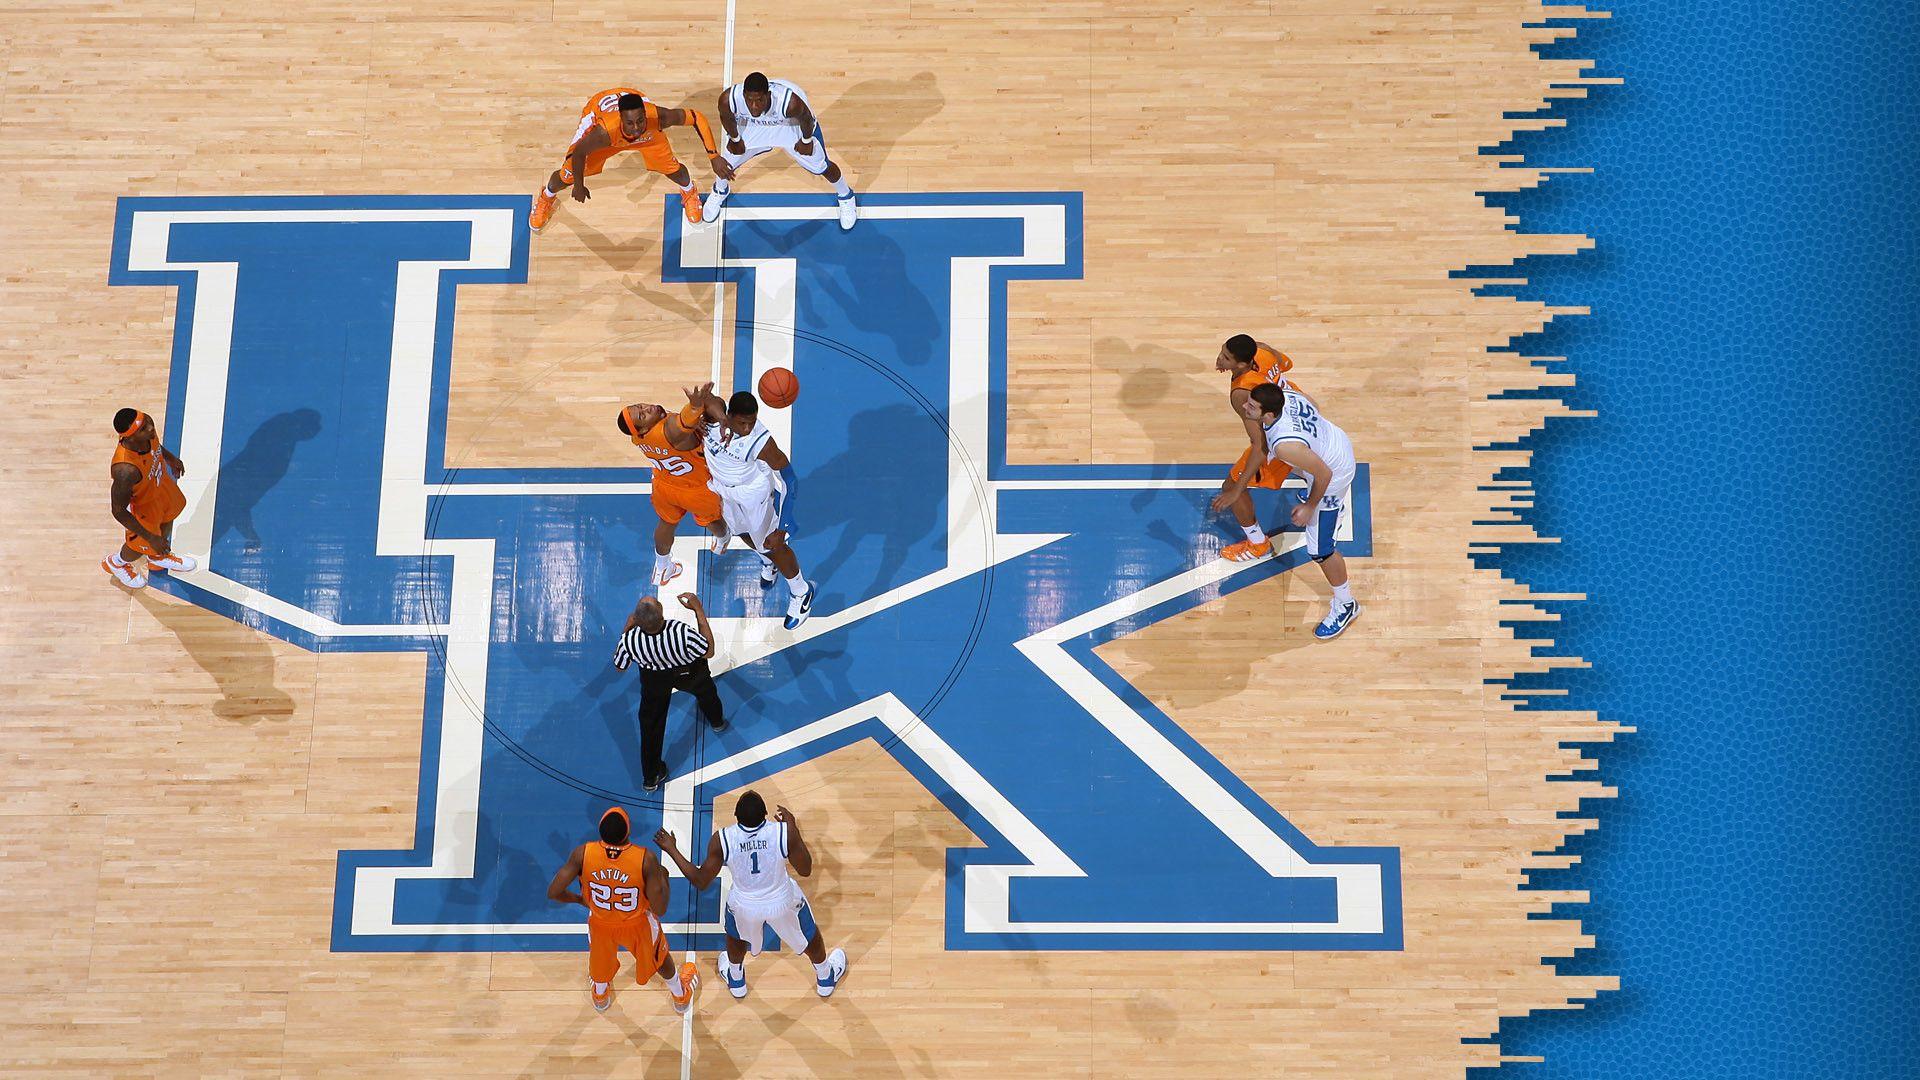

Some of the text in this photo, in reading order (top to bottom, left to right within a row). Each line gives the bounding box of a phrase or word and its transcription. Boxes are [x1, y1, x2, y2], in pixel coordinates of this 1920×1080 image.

[1299, 400, 1318, 438] 55
[1322, 495, 1340, 508] UK
[109, 190, 1404, 951] UK
[739, 840, 768, 853] MILLER
[750, 851, 761, 875] 1
[591, 868, 630, 884] TATUM
[588, 881, 640, 913] 23
